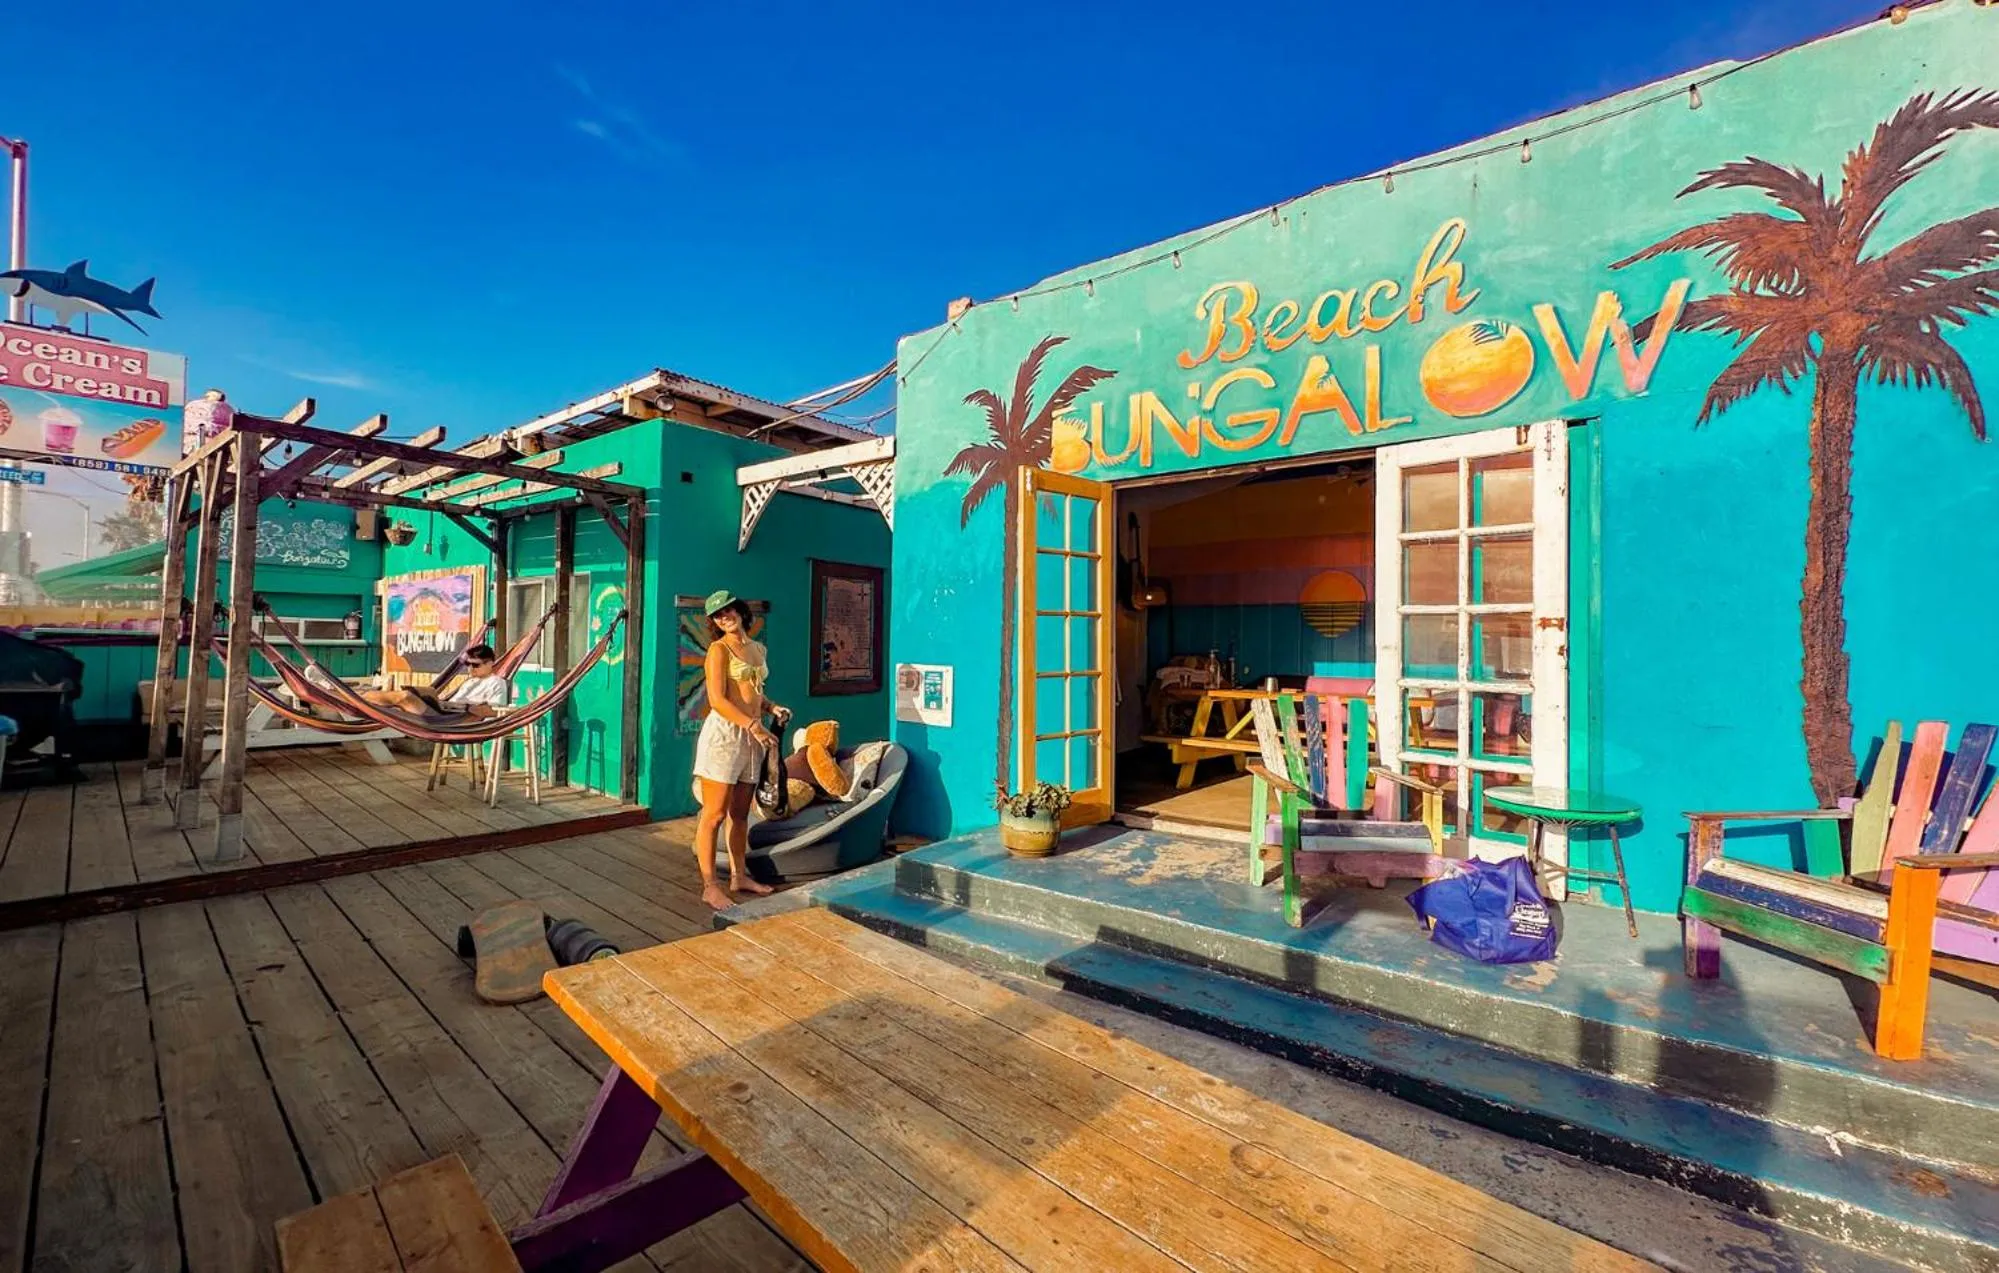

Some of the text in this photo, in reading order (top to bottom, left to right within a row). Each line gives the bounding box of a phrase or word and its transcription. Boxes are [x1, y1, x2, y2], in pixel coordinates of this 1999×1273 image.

[1178, 217, 1481, 369] Beach
[0, 330, 143, 375] cean's
[22, 361, 162, 405] Cream
[1051, 279, 1691, 474] BUNGALOW
[397, 629, 457, 656] BUNGALOW
